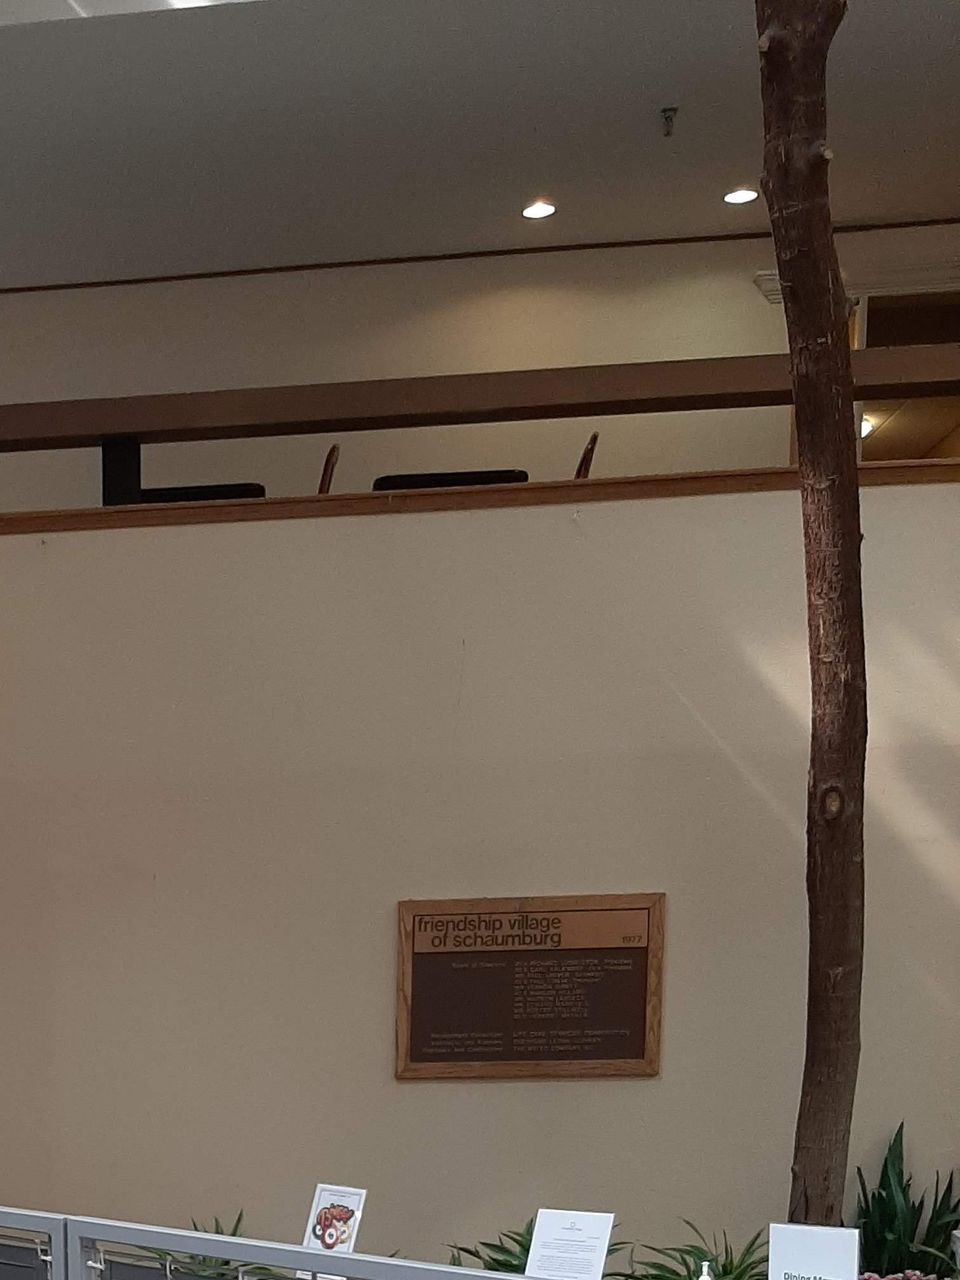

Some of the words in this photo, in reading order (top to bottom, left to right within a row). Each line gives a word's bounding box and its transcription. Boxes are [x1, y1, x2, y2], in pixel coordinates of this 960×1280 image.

[417, 916, 503, 934] friendship
[508, 914, 561, 932] village
[431, 932, 449, 948] of
[452, 932, 561, 948] schaumburg
